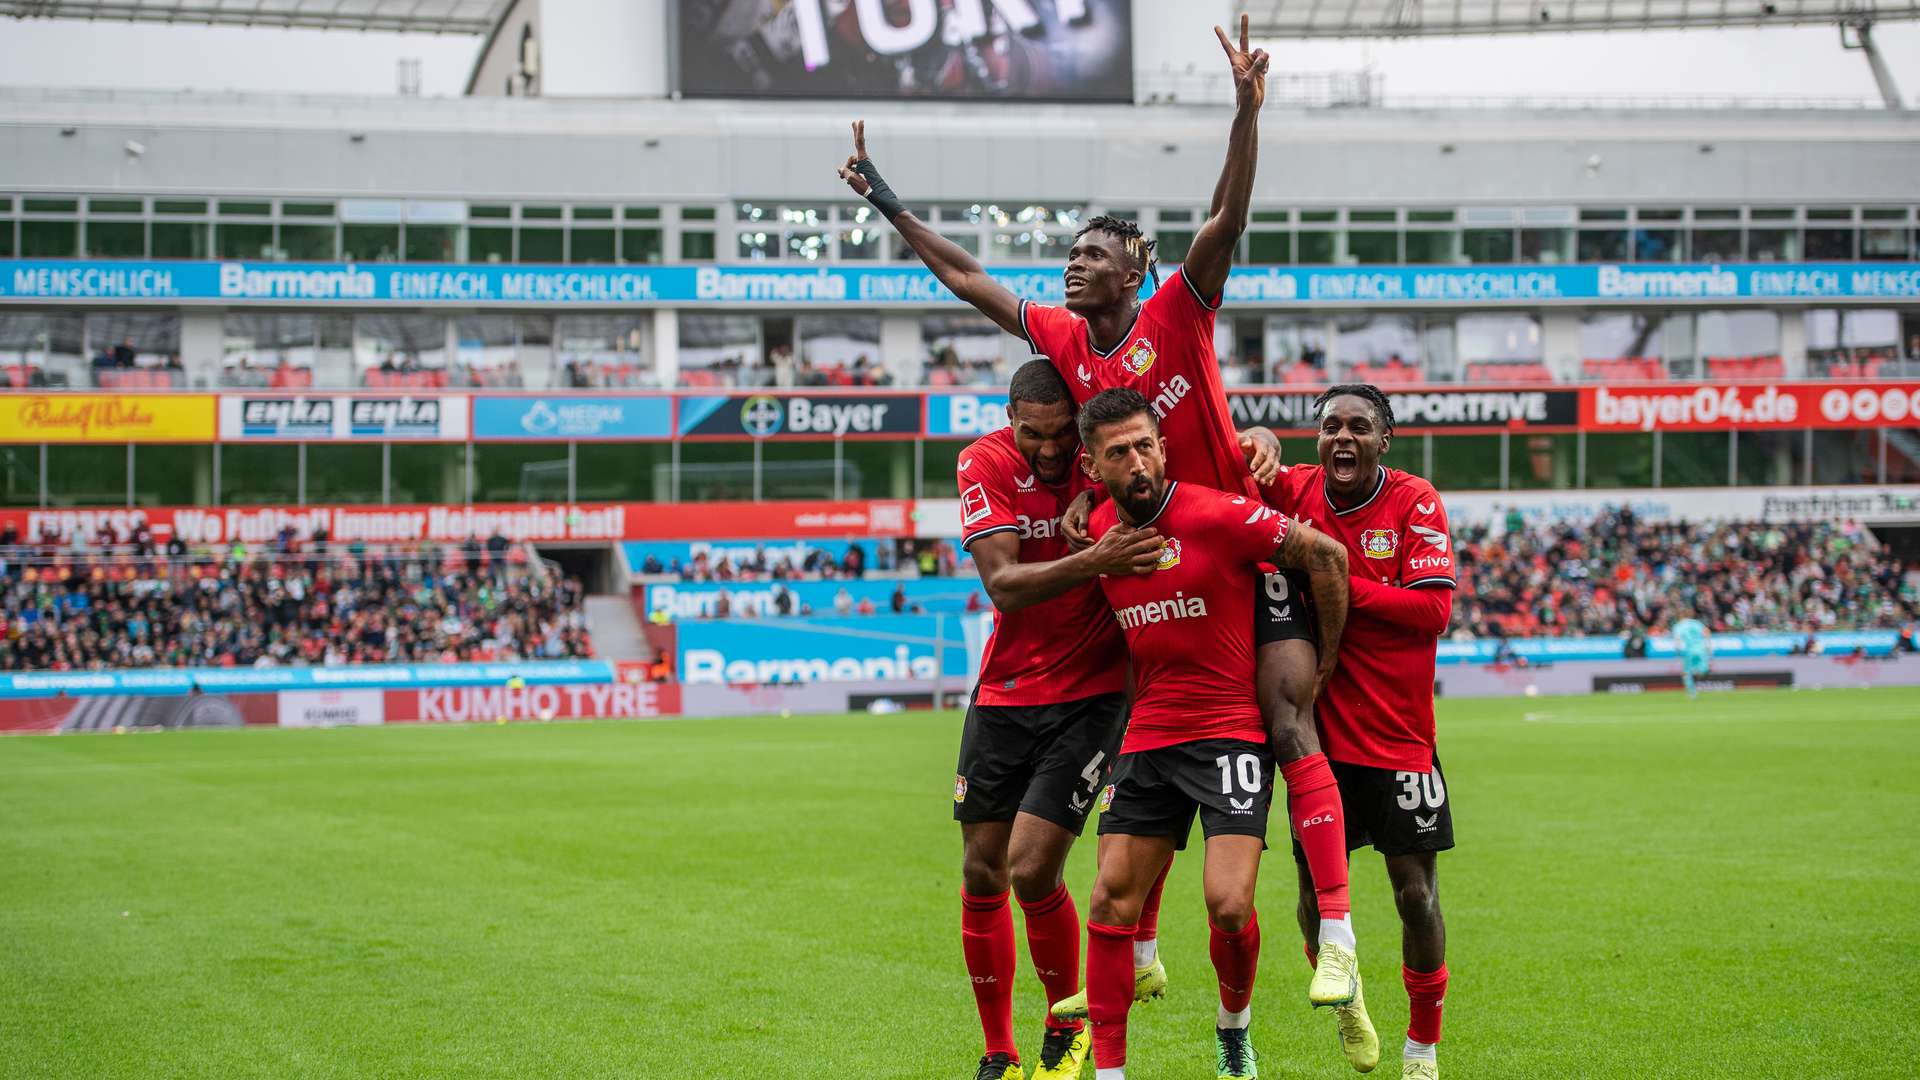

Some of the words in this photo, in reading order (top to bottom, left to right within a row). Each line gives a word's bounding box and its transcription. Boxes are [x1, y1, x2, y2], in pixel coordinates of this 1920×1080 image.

[219, 263, 375, 298] Barmenia
[696, 267, 845, 299] Barmenia
[859, 273, 945, 300] EINFAC
[1225, 267, 1296, 299] enia
[1598, 264, 1738, 296] Barmenia
[1853, 270, 1920, 296] MENSC
[788, 397, 888, 436] Bayer
[1389, 392, 1548, 422] SPORTFIVE
[1595, 387, 1798, 431] bayer04.de
[174, 509, 222, 543] Wo
[334, 507, 425, 541] immer
[1410, 555, 1449, 569] trive
[684, 645, 938, 684] Barmenia
[418, 686, 559, 721] KUMHO
[564, 683, 659, 719] TYRE
[1081, 750, 1105, 793] 4
[1216, 753, 1261, 794] 10
[1396, 765, 1445, 810] 30
